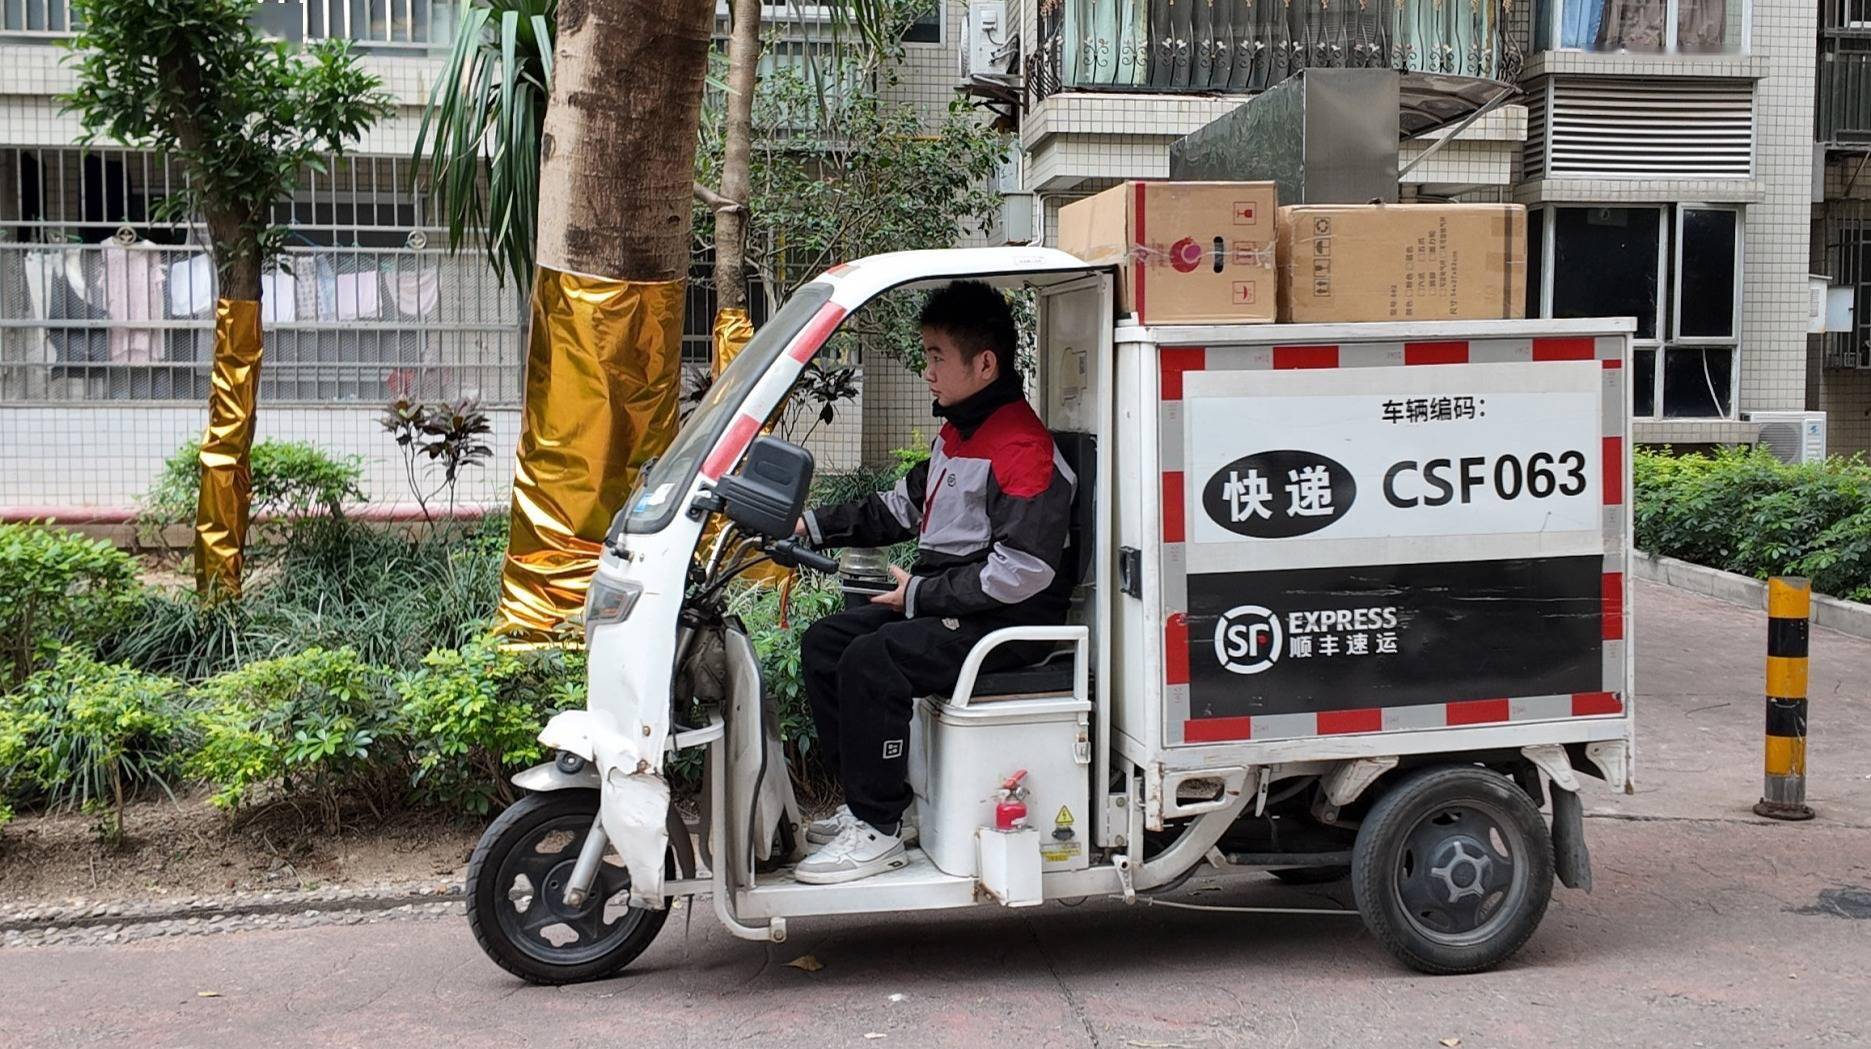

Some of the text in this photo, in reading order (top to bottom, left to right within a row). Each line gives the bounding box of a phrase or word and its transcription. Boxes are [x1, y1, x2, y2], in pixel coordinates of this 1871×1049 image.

[1382, 396, 1485, 424] 车辆编码：
[1222, 465, 1335, 522] 快递
[1383, 450, 1586, 508] CSF063
[1288, 607, 1397, 634] EXPRESS
[1227, 623, 1270, 658] SF
[1289, 632, 1398, 658] 顺丰速运
